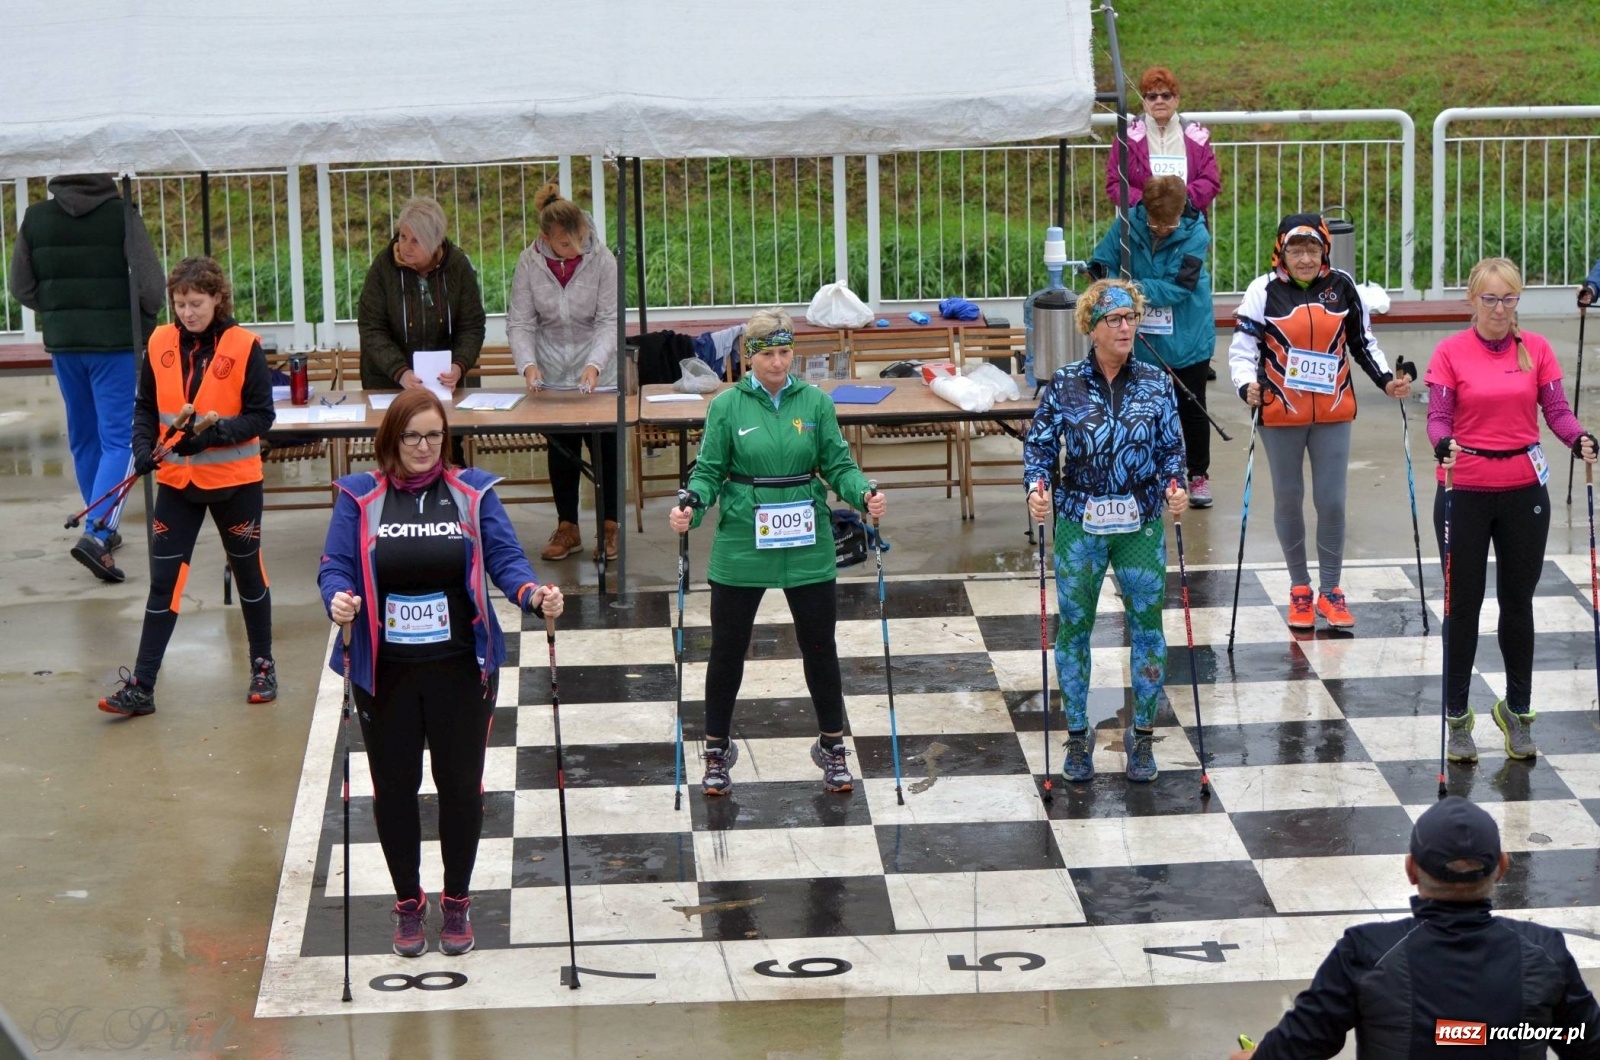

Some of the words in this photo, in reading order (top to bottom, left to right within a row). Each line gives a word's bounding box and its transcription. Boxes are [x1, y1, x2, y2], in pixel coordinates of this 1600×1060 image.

[1153, 163, 1176, 174] 025
[1301, 360, 1327, 376] 015
[1096, 502, 1126, 517] 010
[378, 521, 462, 538] ECATHLON
[772, 513, 801, 529] 009
[400, 604, 434, 621] 004
[1142, 940, 1240, 963] 4
[753, 957, 853, 979] 6
[946, 951, 1046, 972] 5
[369, 971, 468, 992] 8
[560, 965, 656, 986] 7
